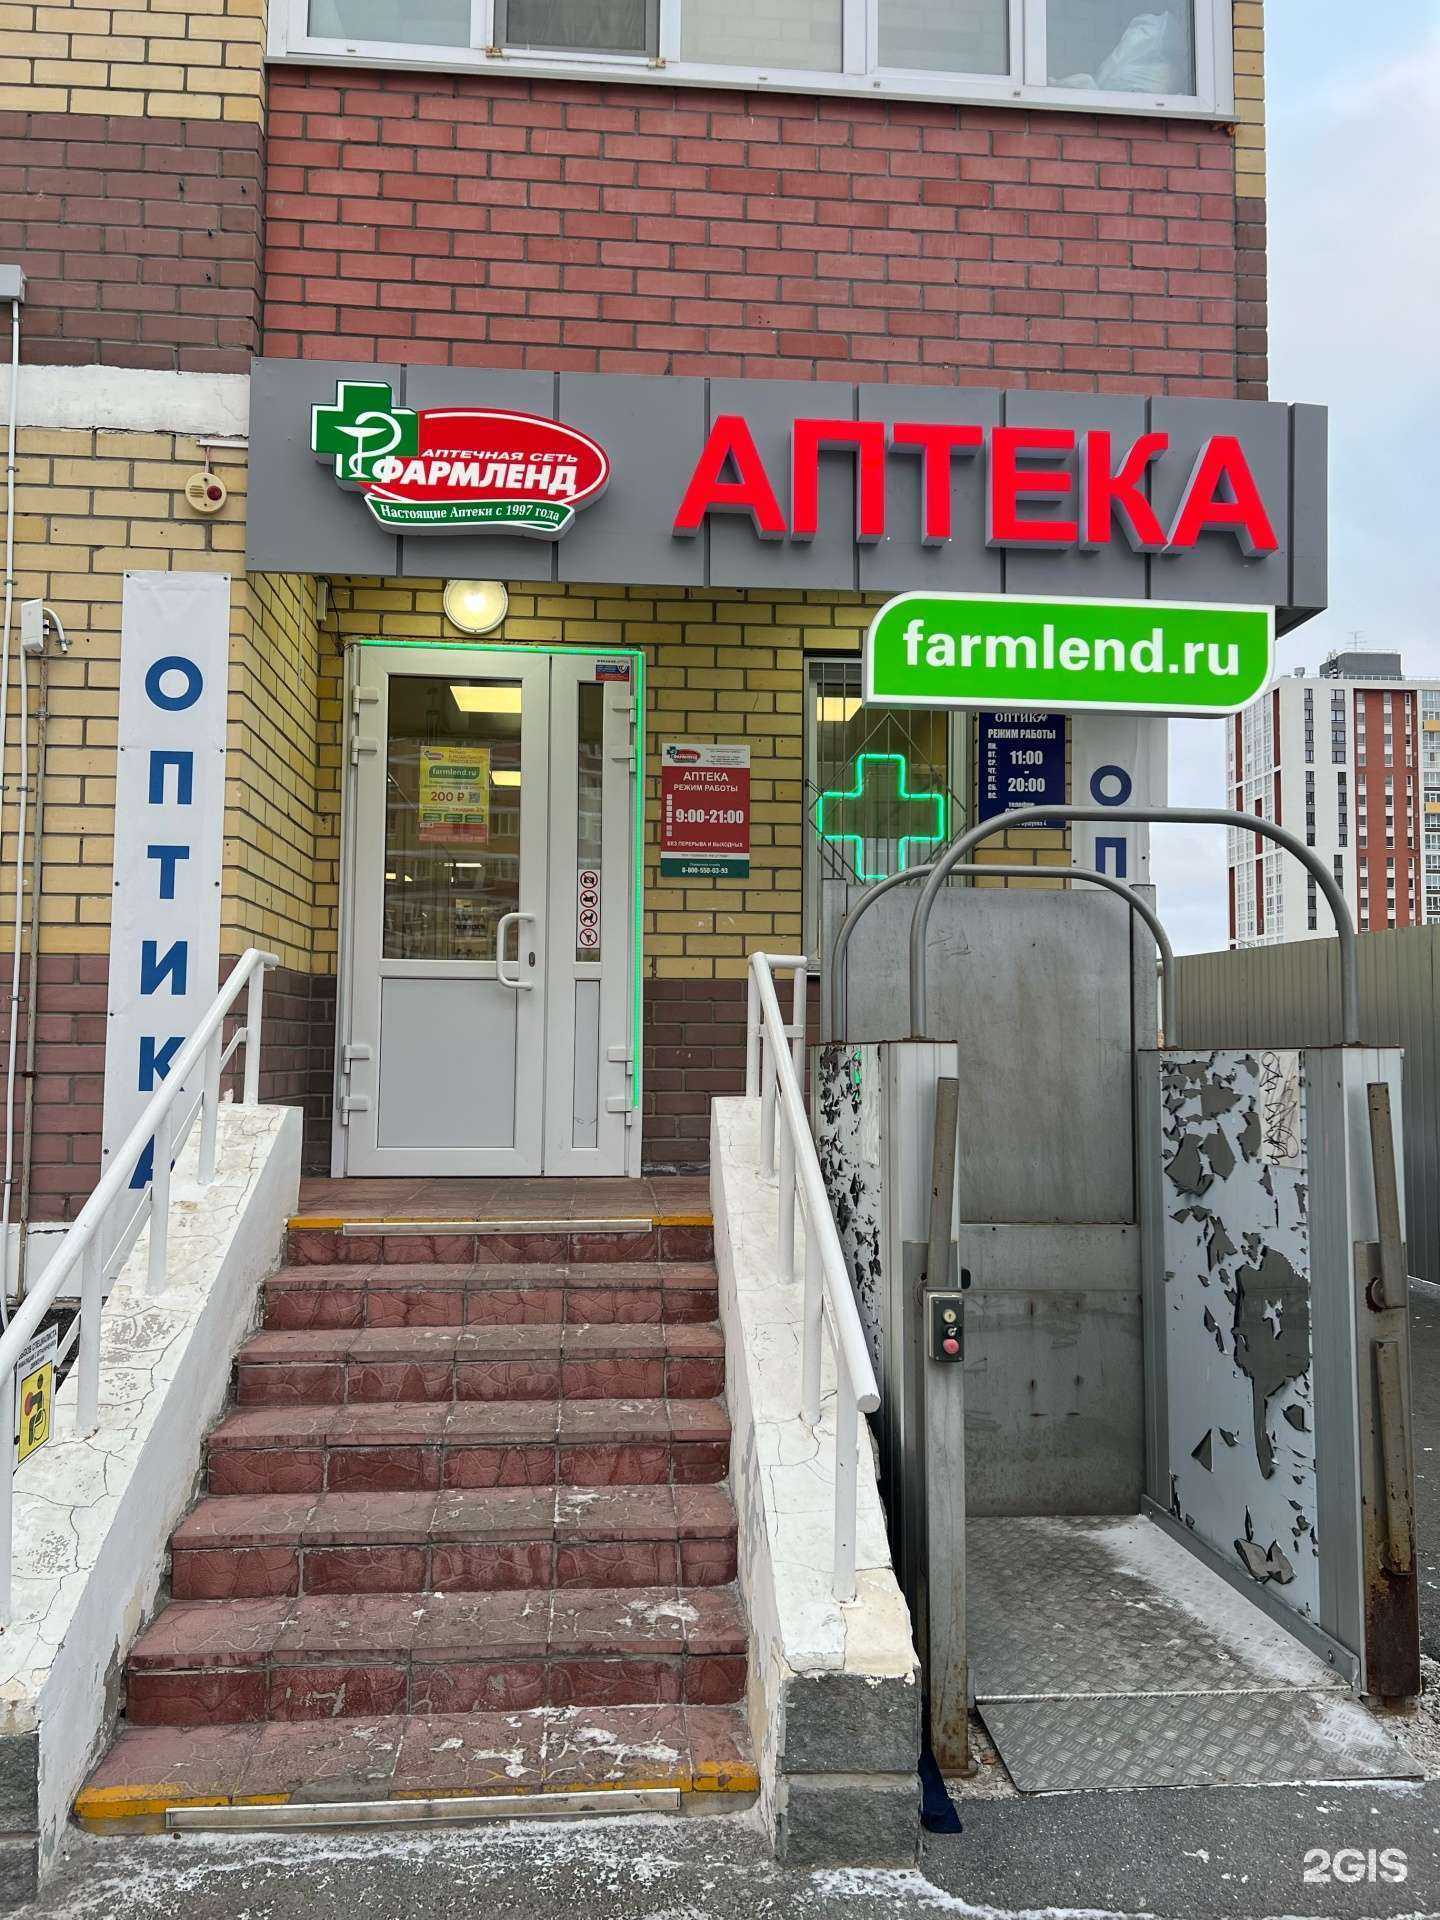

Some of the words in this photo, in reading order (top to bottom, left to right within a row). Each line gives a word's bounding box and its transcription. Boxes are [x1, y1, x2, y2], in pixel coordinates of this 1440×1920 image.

[421, 449, 523, 461] АПТЕЧНАЯ
[529, 452, 578, 463] СЕТЬ
[372, 456, 578, 496] ФАРМЛЕНД
[673, 415, 1279, 554] АПТЕКА
[380, 504, 447, 519] Настоящие
[450, 506, 492, 518] Аптеки
[496, 507, 502, 516] с
[506, 504, 533, 516] 1997
[534, 506, 560, 521] года
[903, 618, 1240, 676] farmlend.ru
[987, 729, 1018, 739] РЕЖИМ
[1020, 730, 1056, 740] РАБОТЫ
[1010, 750, 1043, 765] 11:00
[432, 767, 477, 776] farmlend.ru
[683, 771, 729, 782] АПТЕКА
[673, 783, 702, 791] РЕЖИМ
[704, 784, 738, 792] РАБОТЫ
[1008, 778, 1045, 792] 20:00
[431, 791, 454, 801] 200
[675, 808, 744, 824] 9:00-21:00
